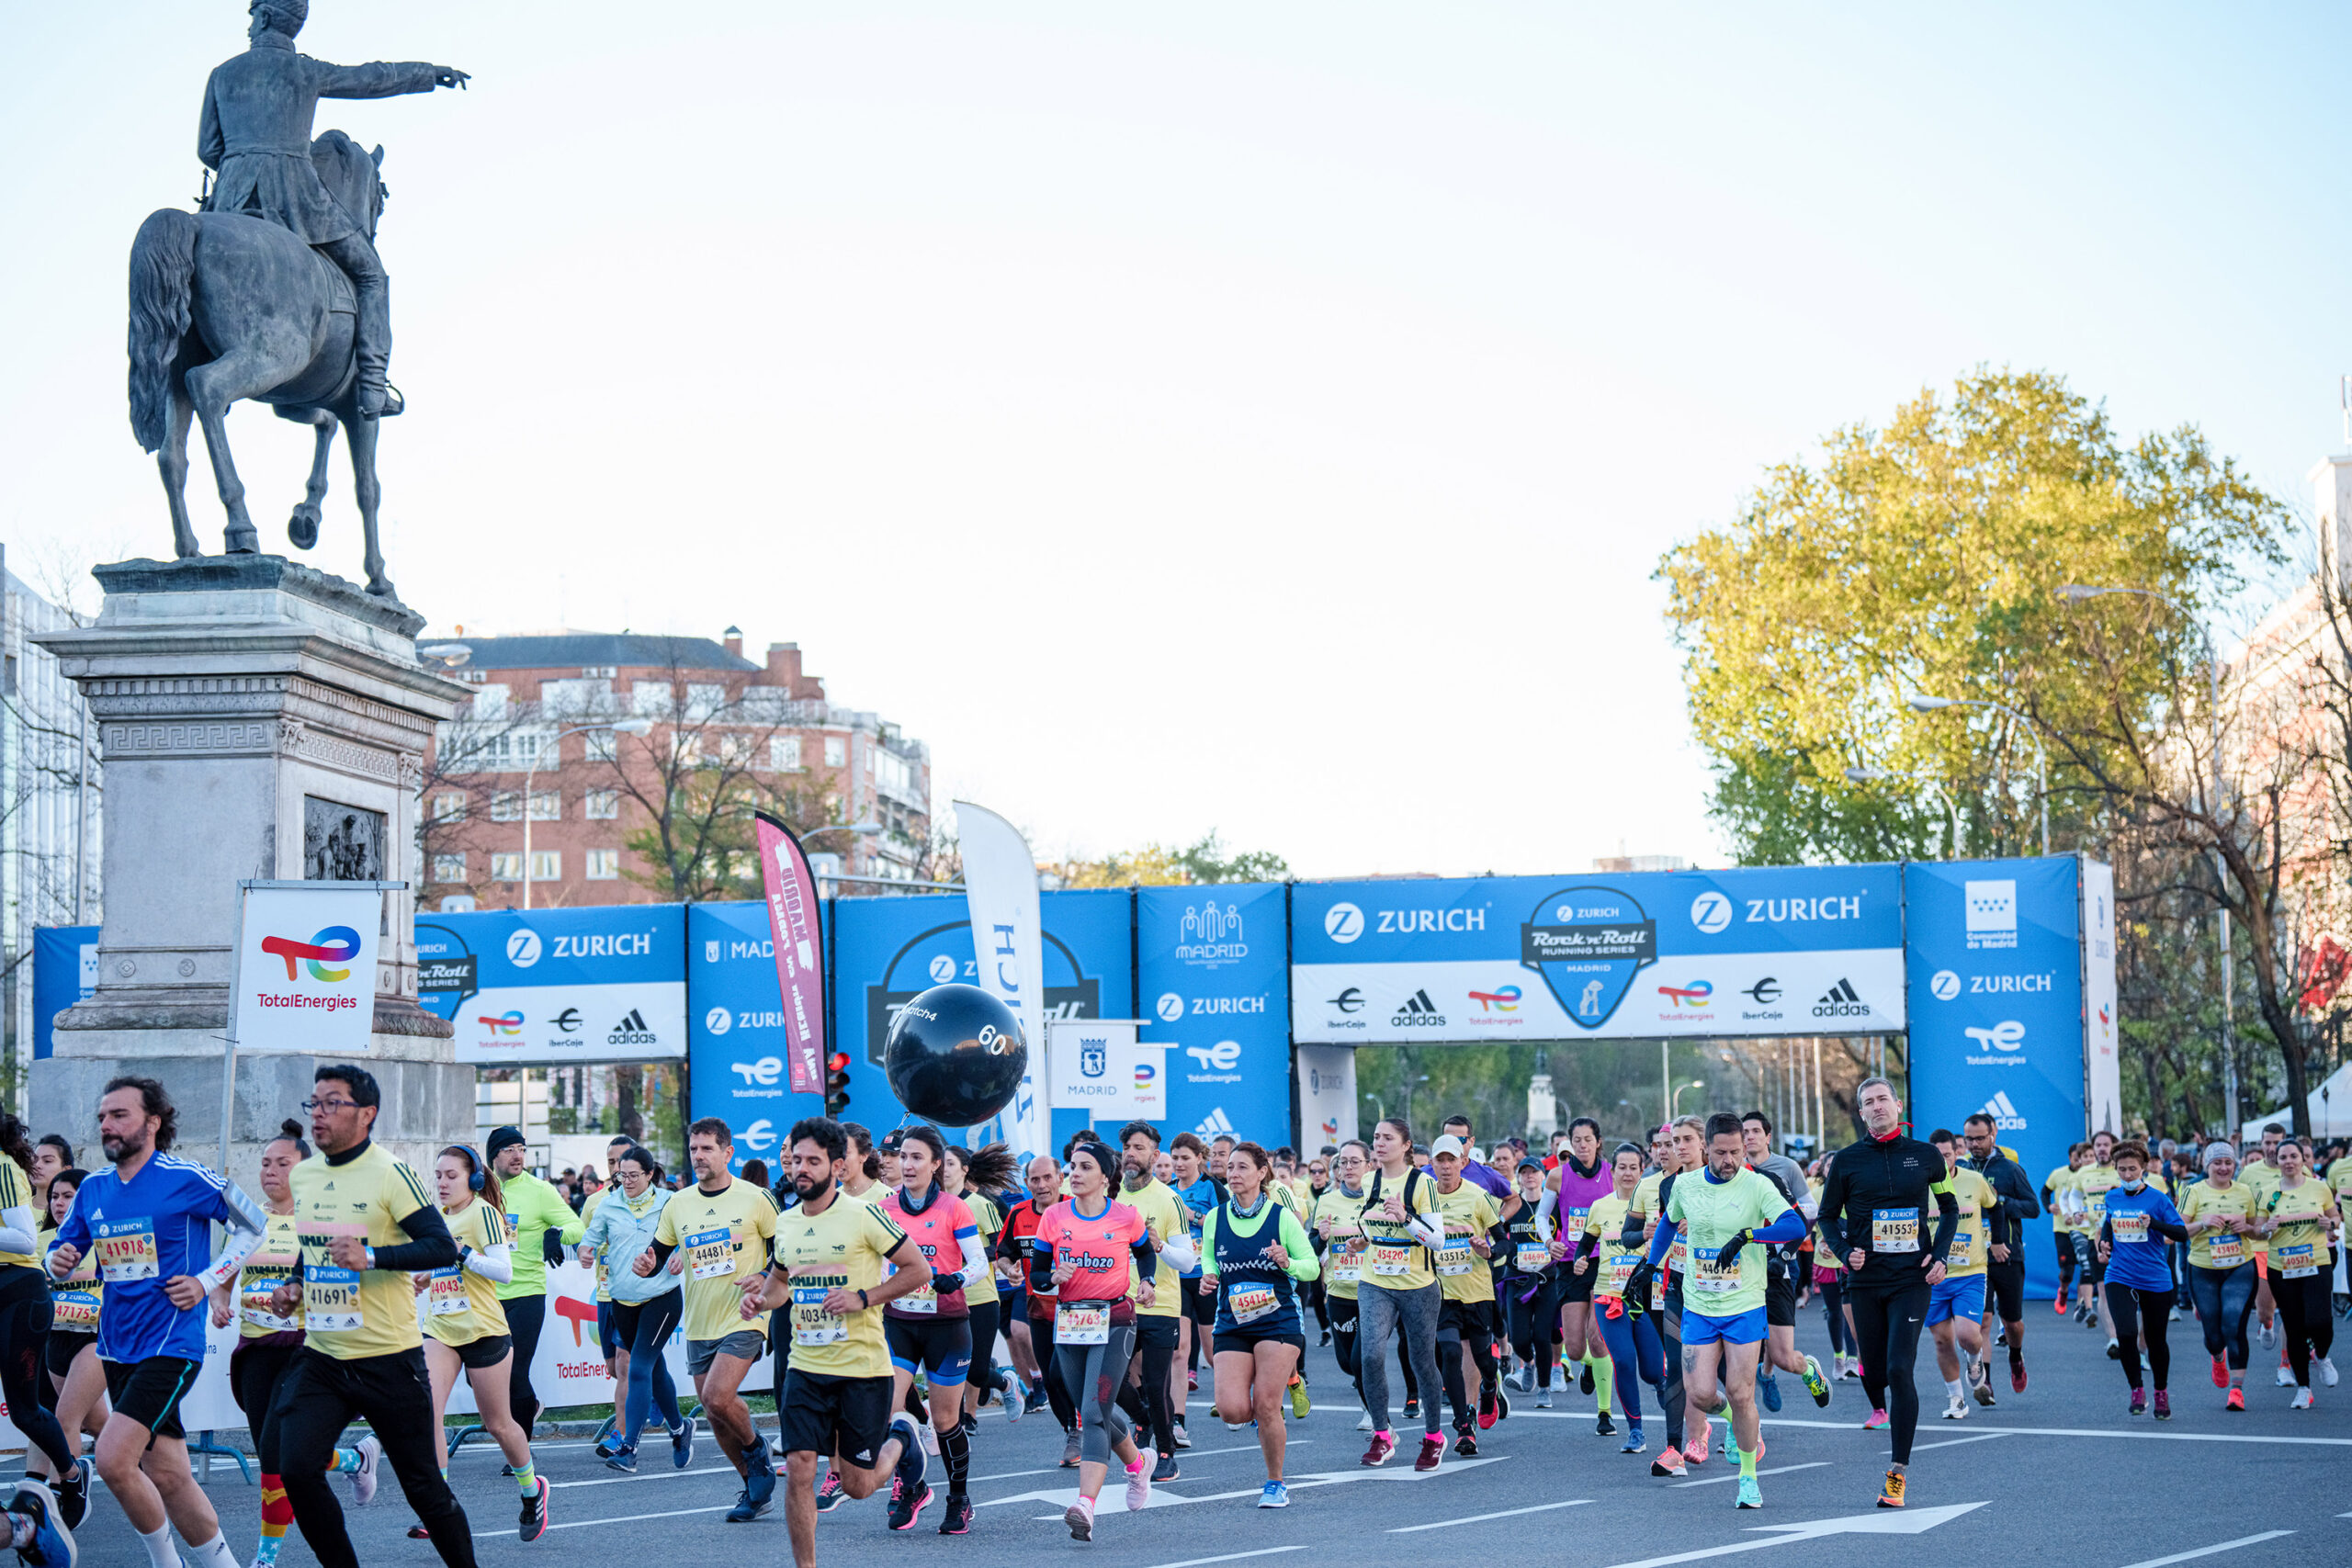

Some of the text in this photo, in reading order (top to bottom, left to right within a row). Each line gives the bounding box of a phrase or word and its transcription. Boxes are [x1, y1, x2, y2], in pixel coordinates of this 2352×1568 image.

[1577, 908, 1620, 919] ZURICH
[1747, 897, 1860, 922] ZURICH
[1377, 908, 1486, 933] ZURICH
[1967, 931, 2018, 940] Comunidad
[417, 944, 447, 953] URICH
[553, 934, 650, 957] ZURICH
[732, 941, 775, 959] MAD
[1543, 945, 1635, 955] RUNNING SERIES
[1176, 944, 1249, 959] MADRID
[1566, 964, 1611, 973] MADRID
[425, 978, 460, 987] SERIES
[1971, 975, 2052, 993] ZURICH
[257, 994, 357, 1012] TotalEnergies
[1193, 998, 1265, 1014] ZURICH
[1813, 1002, 1871, 1017] adidas
[739, 1011, 785, 1028] ZURI
[1391, 1014, 1446, 1027] adidas
[1658, 1013, 1714, 1021] TotalEnergies
[1742, 1011, 1783, 1021] iberCaja
[1328, 1021, 1366, 1031] iberCaja
[1468, 1017, 1523, 1027] TotalEnergies
[607, 1030, 657, 1044] adidas
[978, 1024, 1007, 1055] 60
[478, 1041, 526, 1049] TotalEnergies
[548, 1039, 584, 1049] iberCaja
[1965, 1057, 2027, 1066] TotalEnergies
[1187, 1075, 1242, 1084] TotalEnergies
[731, 1089, 784, 1099] TotalEnergies
[1068, 1085, 1118, 1096] MADRID
[1996, 1117, 2028, 1132] das
[1891, 1211, 1914, 1219] ZURICH
[112, 1223, 142, 1234] ZURICH
[1881, 1224, 1912, 1235] 41553
[2117, 1221, 2140, 1230] 44944
[701, 1232, 724, 1242] ZURICH
[106, 1239, 145, 1258] 41918
[695, 1245, 726, 1262] 44481
[1951, 1244, 1965, 1253] 360
[1376, 1249, 1404, 1261] 45420
[1439, 1249, 1466, 1263] 43515
[1522, 1252, 1546, 1262] 44699
[319, 1270, 349, 1280] ZURICH
[1614, 1268, 1632, 1279] 446
[69, 1293, 95, 1303] ZURICH
[251, 1295, 274, 1307] 436
[311, 1289, 347, 1305] 41691
[806, 1291, 828, 1302] ZURIC
[1238, 1293, 1267, 1309] 45414
[55, 1305, 90, 1320] 47175
[1066, 1314, 1101, 1327] 44763
[557, 1361, 612, 1380] TotalEnerg
